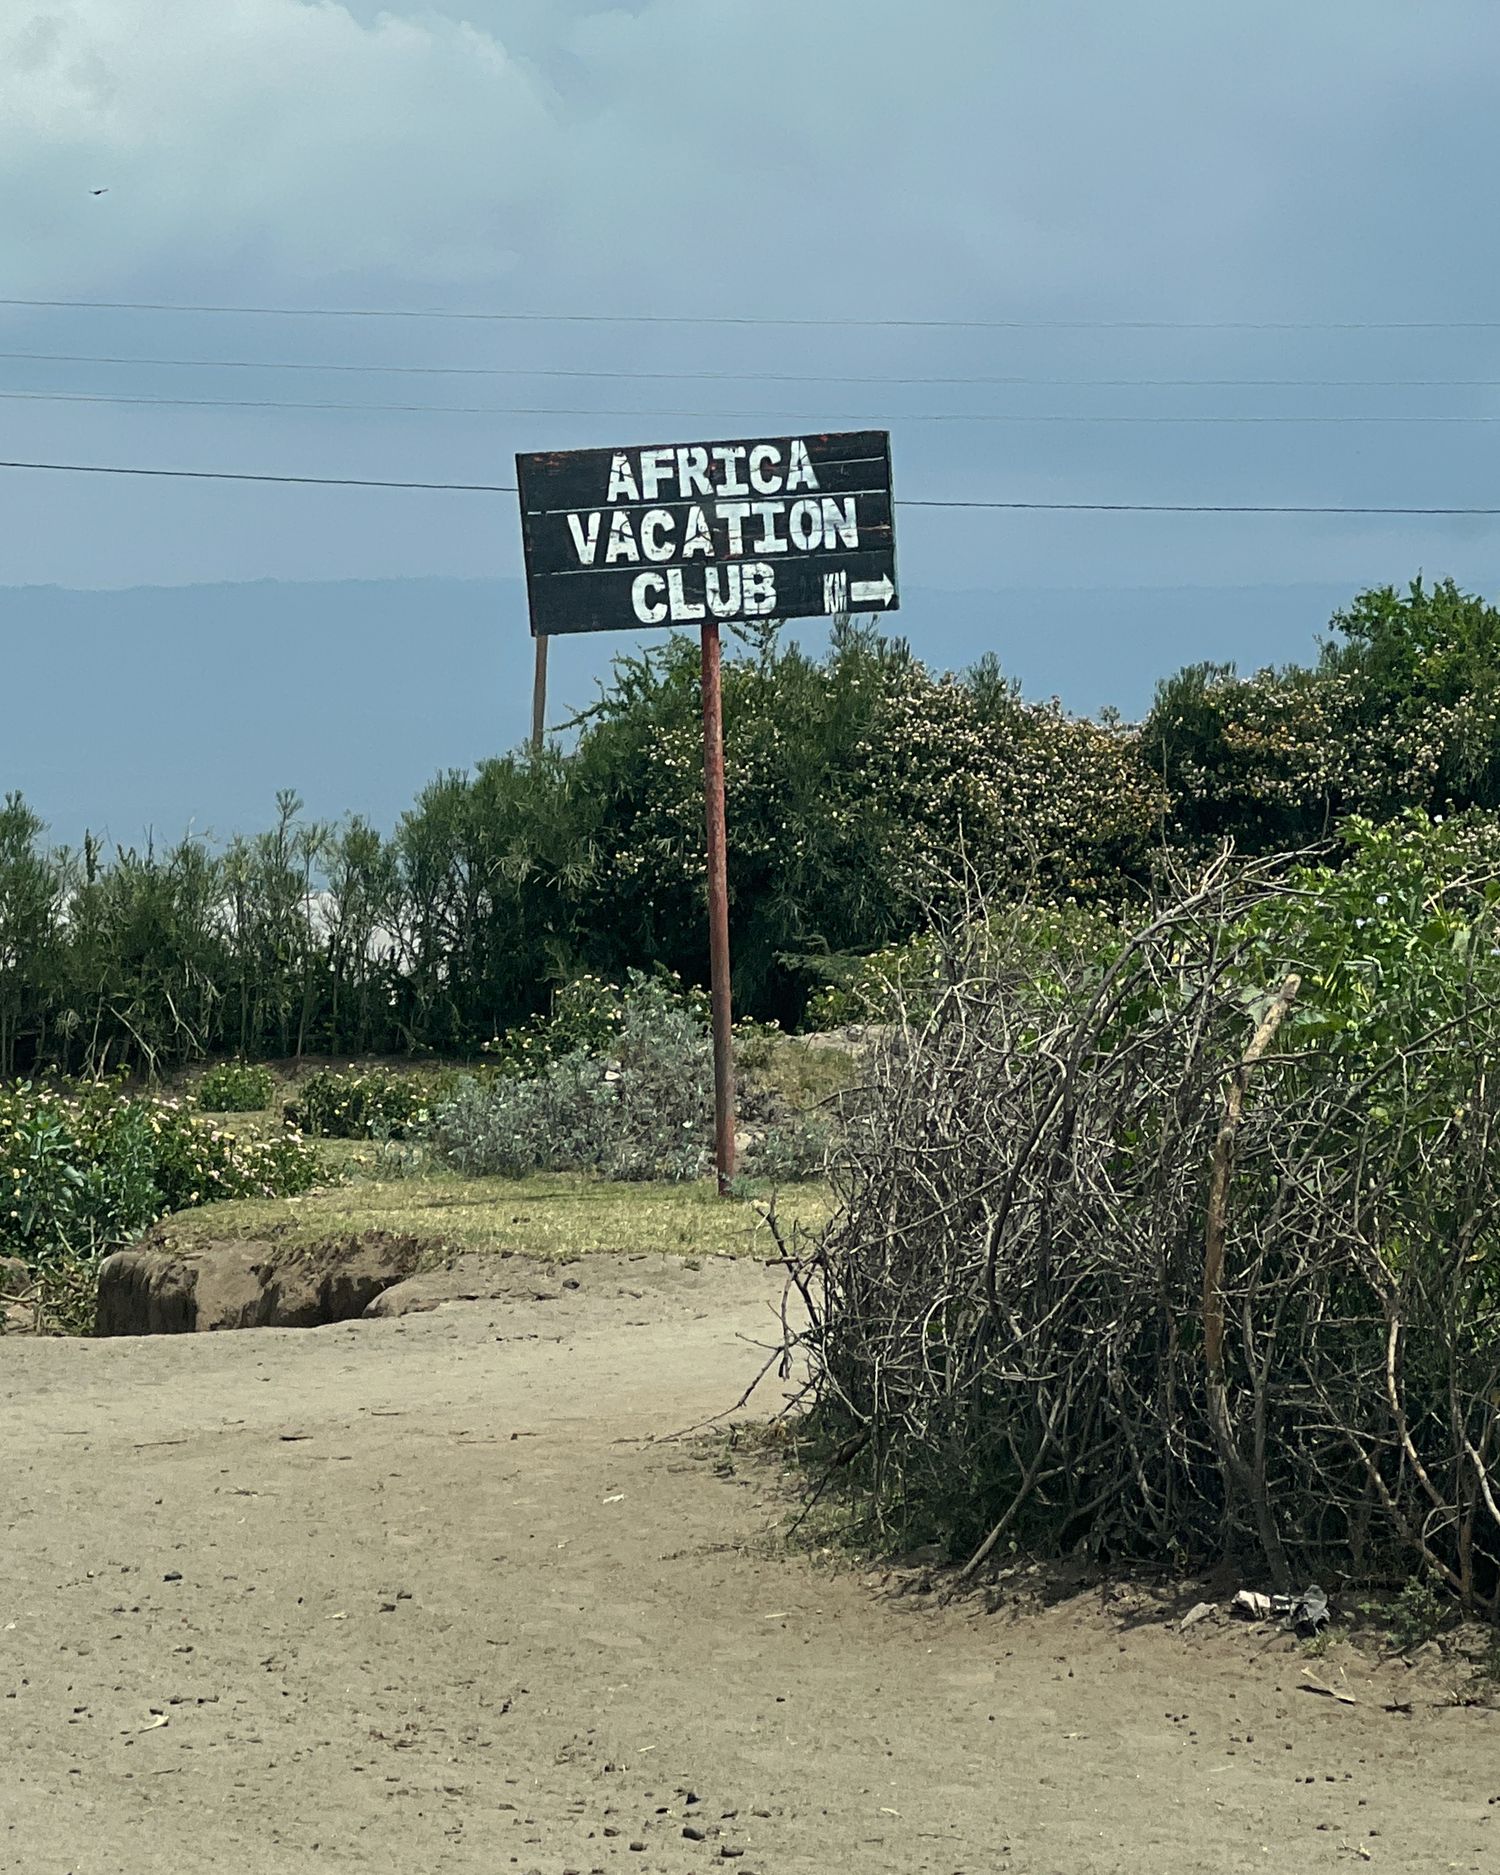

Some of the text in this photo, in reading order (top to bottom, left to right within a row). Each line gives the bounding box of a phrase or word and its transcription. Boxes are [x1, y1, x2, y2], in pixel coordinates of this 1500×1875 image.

[606, 440, 820, 502] AFRICA
[566, 497, 859, 565] VACATION
[631, 562, 777, 624] CLUB
